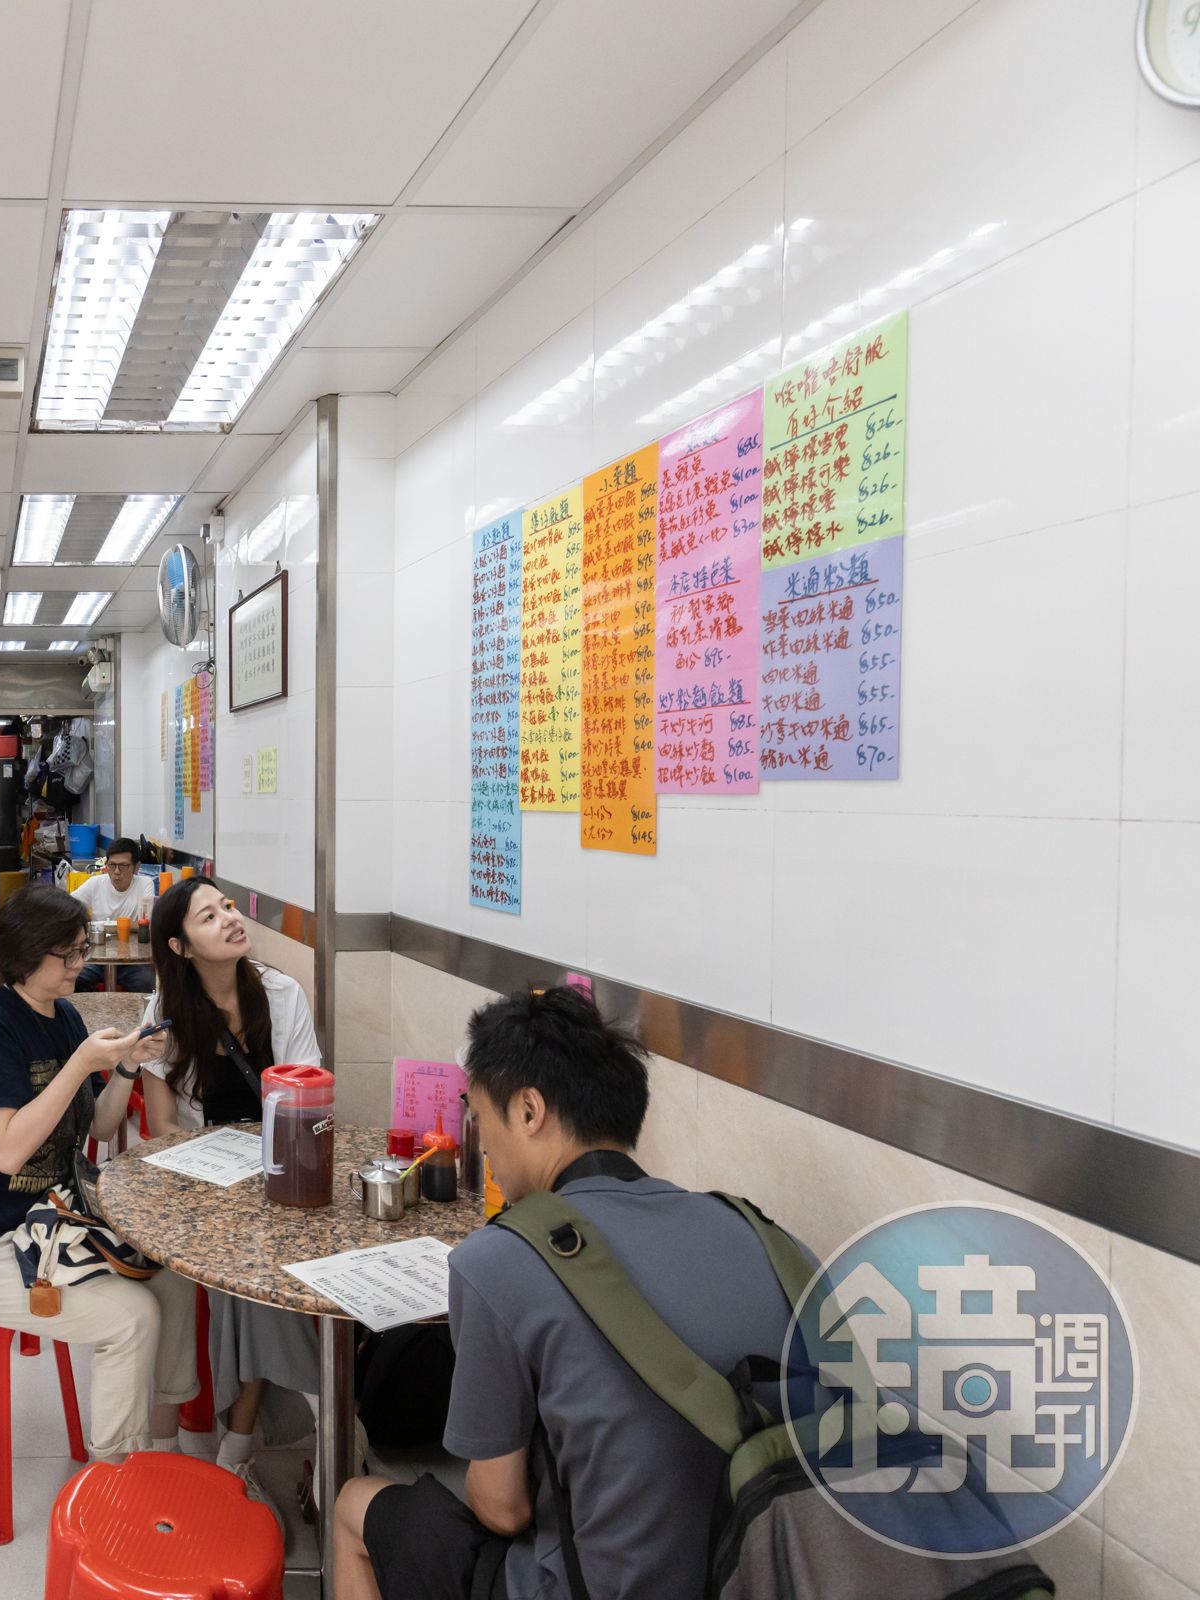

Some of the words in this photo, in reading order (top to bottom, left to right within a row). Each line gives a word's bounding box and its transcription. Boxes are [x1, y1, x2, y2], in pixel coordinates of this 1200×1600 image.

[669, 556, 735, 595] 本店特色菜
[660, 713, 713, 736] 干炒牛河
